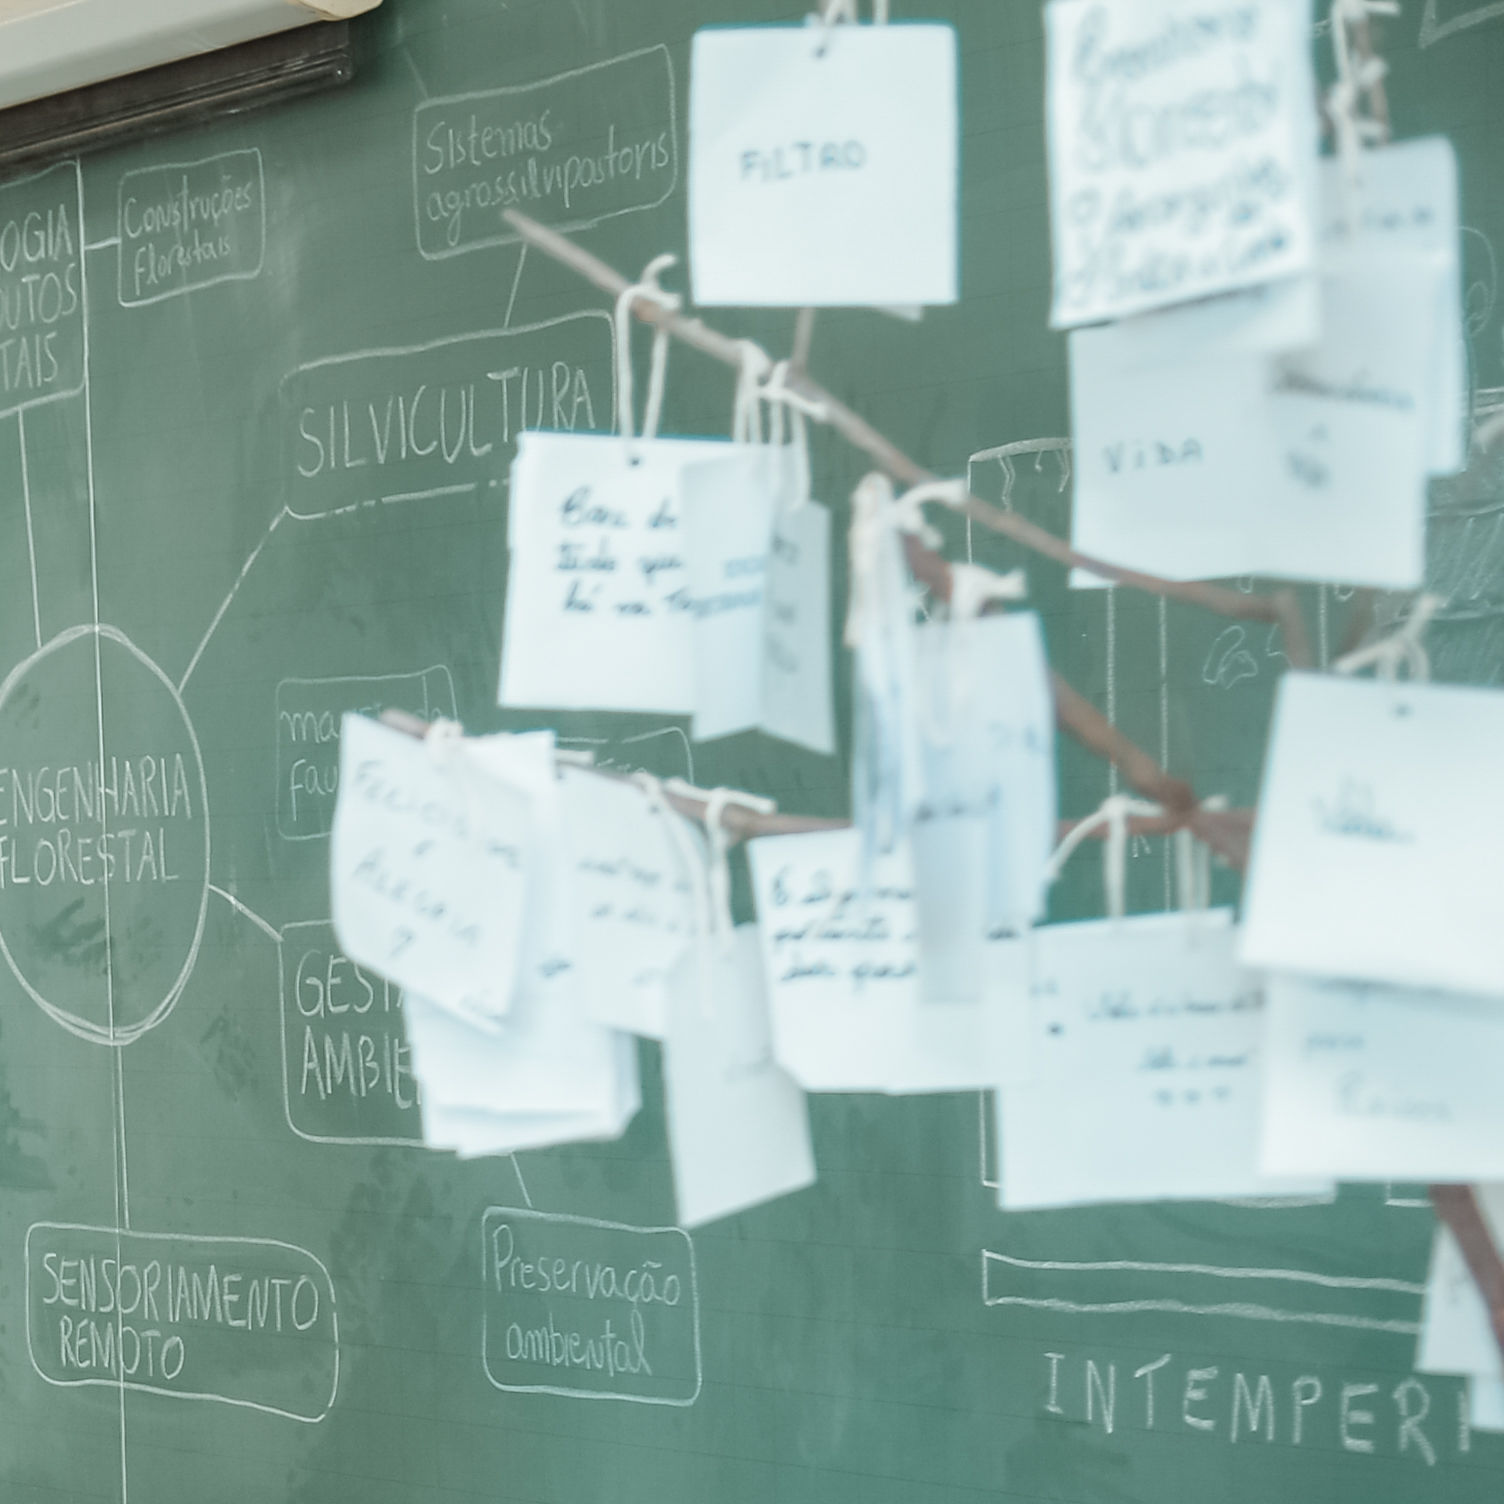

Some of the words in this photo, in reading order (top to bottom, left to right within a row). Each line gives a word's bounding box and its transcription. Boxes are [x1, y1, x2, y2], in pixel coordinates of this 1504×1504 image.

[426, 109, 552, 175] Sistemas
[740, 140, 867, 182] FILTRO
[297, 361, 597, 477] SILVICULTURA
[289, 758, 337, 822] fau
[301, 1025, 422, 1110] AMBIE
[43, 1252, 319, 1331] SENSORIAMENTO
[493, 1222, 682, 1306] Preservação
[60, 1315, 184, 1379] REMOTO
[505, 1310, 652, 1378] ambiental
[1043, 1352, 1471, 1466] INTEMPERI
